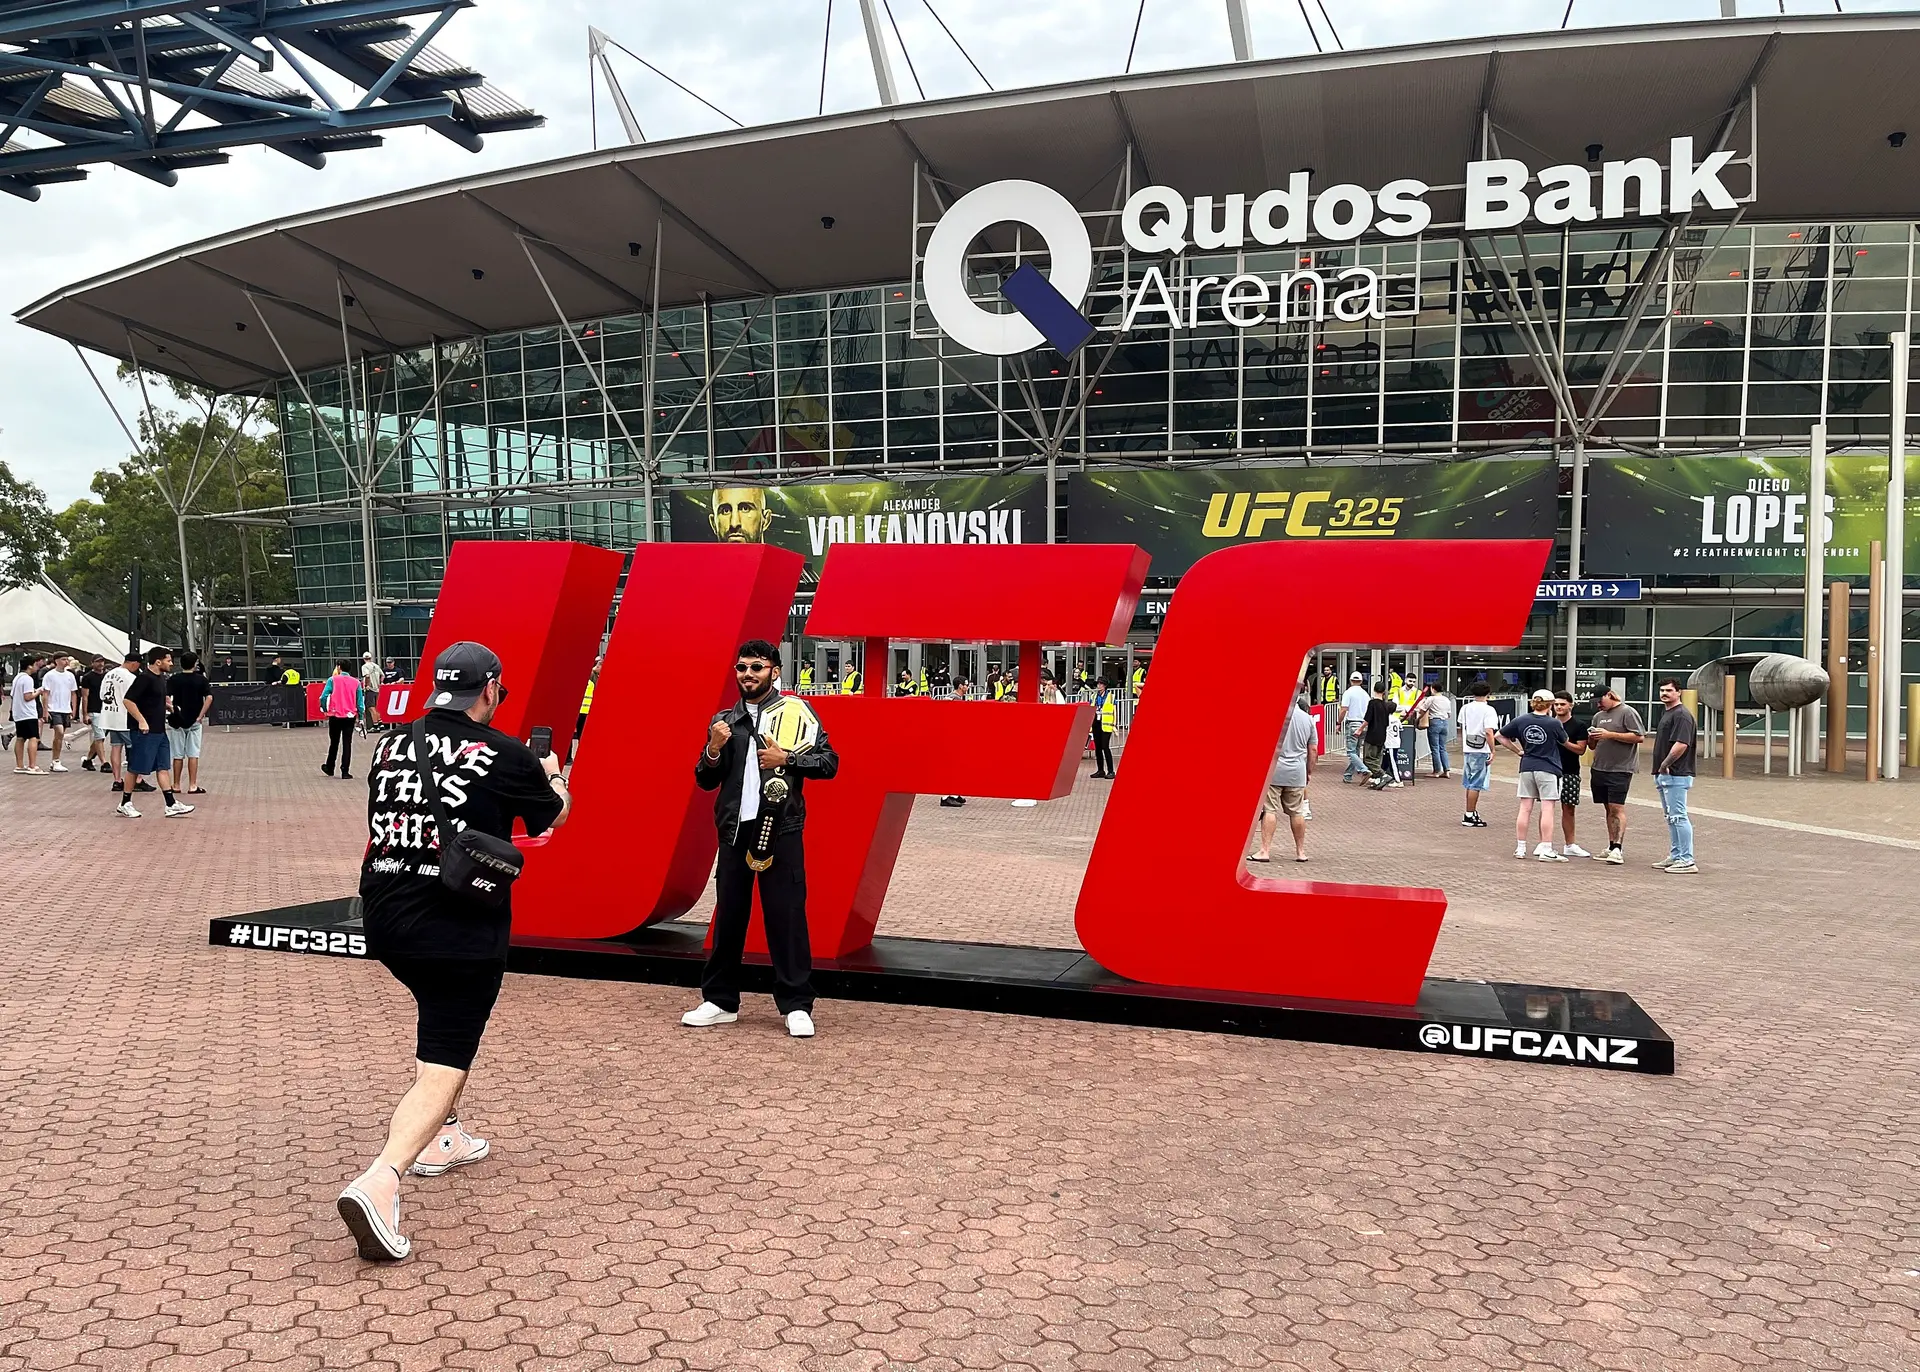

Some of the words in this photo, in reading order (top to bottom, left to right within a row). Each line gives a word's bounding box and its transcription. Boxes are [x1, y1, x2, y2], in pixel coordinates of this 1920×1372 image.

[1123, 172, 1432, 254] Qudos
[1465, 136, 1747, 233] Bank
[1122, 265, 1386, 332] Arena
[1748, 478, 1790, 492] DIEGO
[882, 498, 941, 512] ALEXANDER
[1201, 491, 1331, 538] UFC
[1328, 497, 1404, 528] 325
[1673, 548, 1690, 557] #2
[1695, 548, 1788, 557] FEATHERWEIGHT
[1793, 548, 1860, 557] COENDER
[1536, 584, 1587, 597] ENTRY
[1591, 584, 1602, 596] B
[436, 669, 461, 681] UFC
[387, 734, 498, 777] LOVE
[409, 539, 1553, 1006] UFC
[471, 877, 497, 892] UFC
[229, 924, 367, 956] #UFC325
[1419, 1023, 1639, 1065] @UFCANZ
